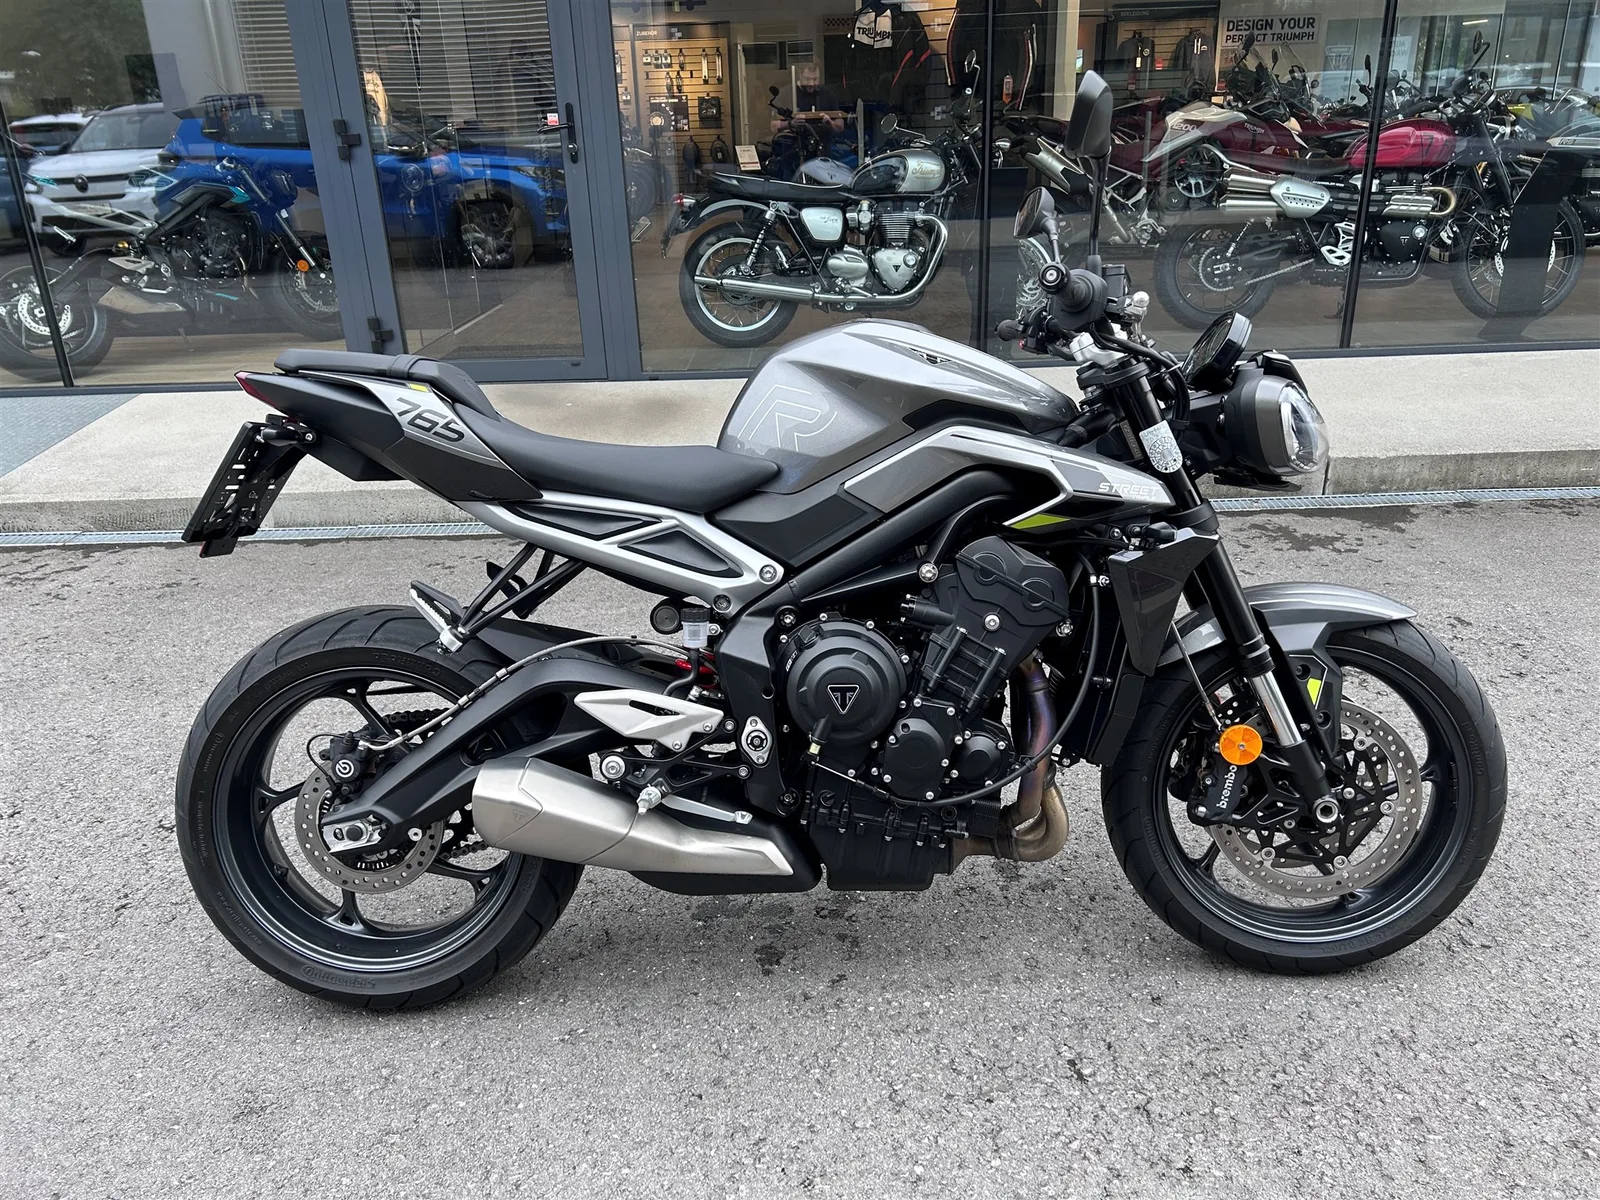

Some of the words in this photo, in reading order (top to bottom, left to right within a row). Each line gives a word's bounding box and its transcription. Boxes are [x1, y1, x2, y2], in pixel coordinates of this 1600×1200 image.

[1226, 18, 1274, 32] DESIGN
[1279, 17, 1316, 31] YOUR
[1225, 33, 1268, 43] PERCT
[1271, 31, 1315, 42] TRIUMPH
[396, 396, 465, 443] 765
[1098, 481, 1160, 496] STREET
[1215, 764, 1238, 809] brembo
